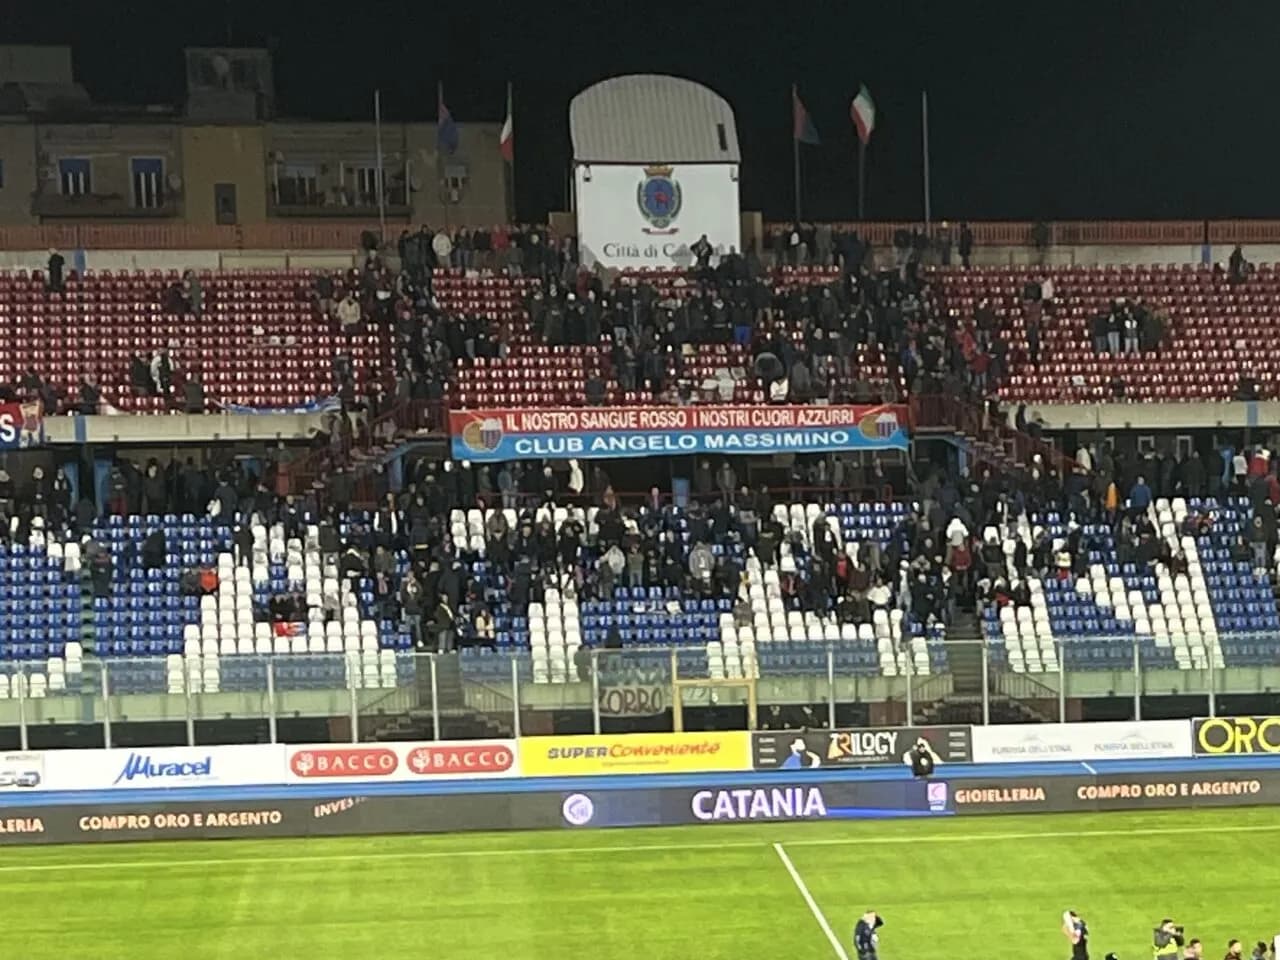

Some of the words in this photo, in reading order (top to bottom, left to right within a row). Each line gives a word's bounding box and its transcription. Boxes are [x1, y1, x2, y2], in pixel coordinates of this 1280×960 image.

[644, 243, 658, 258] di
[506, 412, 520, 431] IL
[522, 411, 578, 431] NOSTRO
[580, 410, 638, 430] SANGUE
[640, 410, 687, 428] ROSSO
[693, 410, 697, 428] I
[700, 409, 749, 428] NOSTRI
[752, 408, 795, 427] CUORI
[797, 408, 854, 426] AZZURRI
[515, 436, 583, 455] CLUB
[591, 434, 698, 452] ANGELO
[704, 430, 849, 449] MASSIMINO
[828, 732, 898, 760] TRILOGY
[318, 755, 394, 771] BACCO
[433, 751, 509, 768] BACCO
[955, 787, 1046, 803] GIOIELLERIA
[1077, 784, 1141, 800] COMPRO
[1144, 783, 1175, 797] ORO
[1180, 782, 1188, 796] E
[1191, 780, 1261, 795] ARGENTO
[692, 787, 827, 820] CATANIA
[79, 814, 151, 831] COMPRO
[154, 813, 190, 829] ORO
[194, 813, 203, 827] E
[206, 811, 282, 827] ARGENTO
